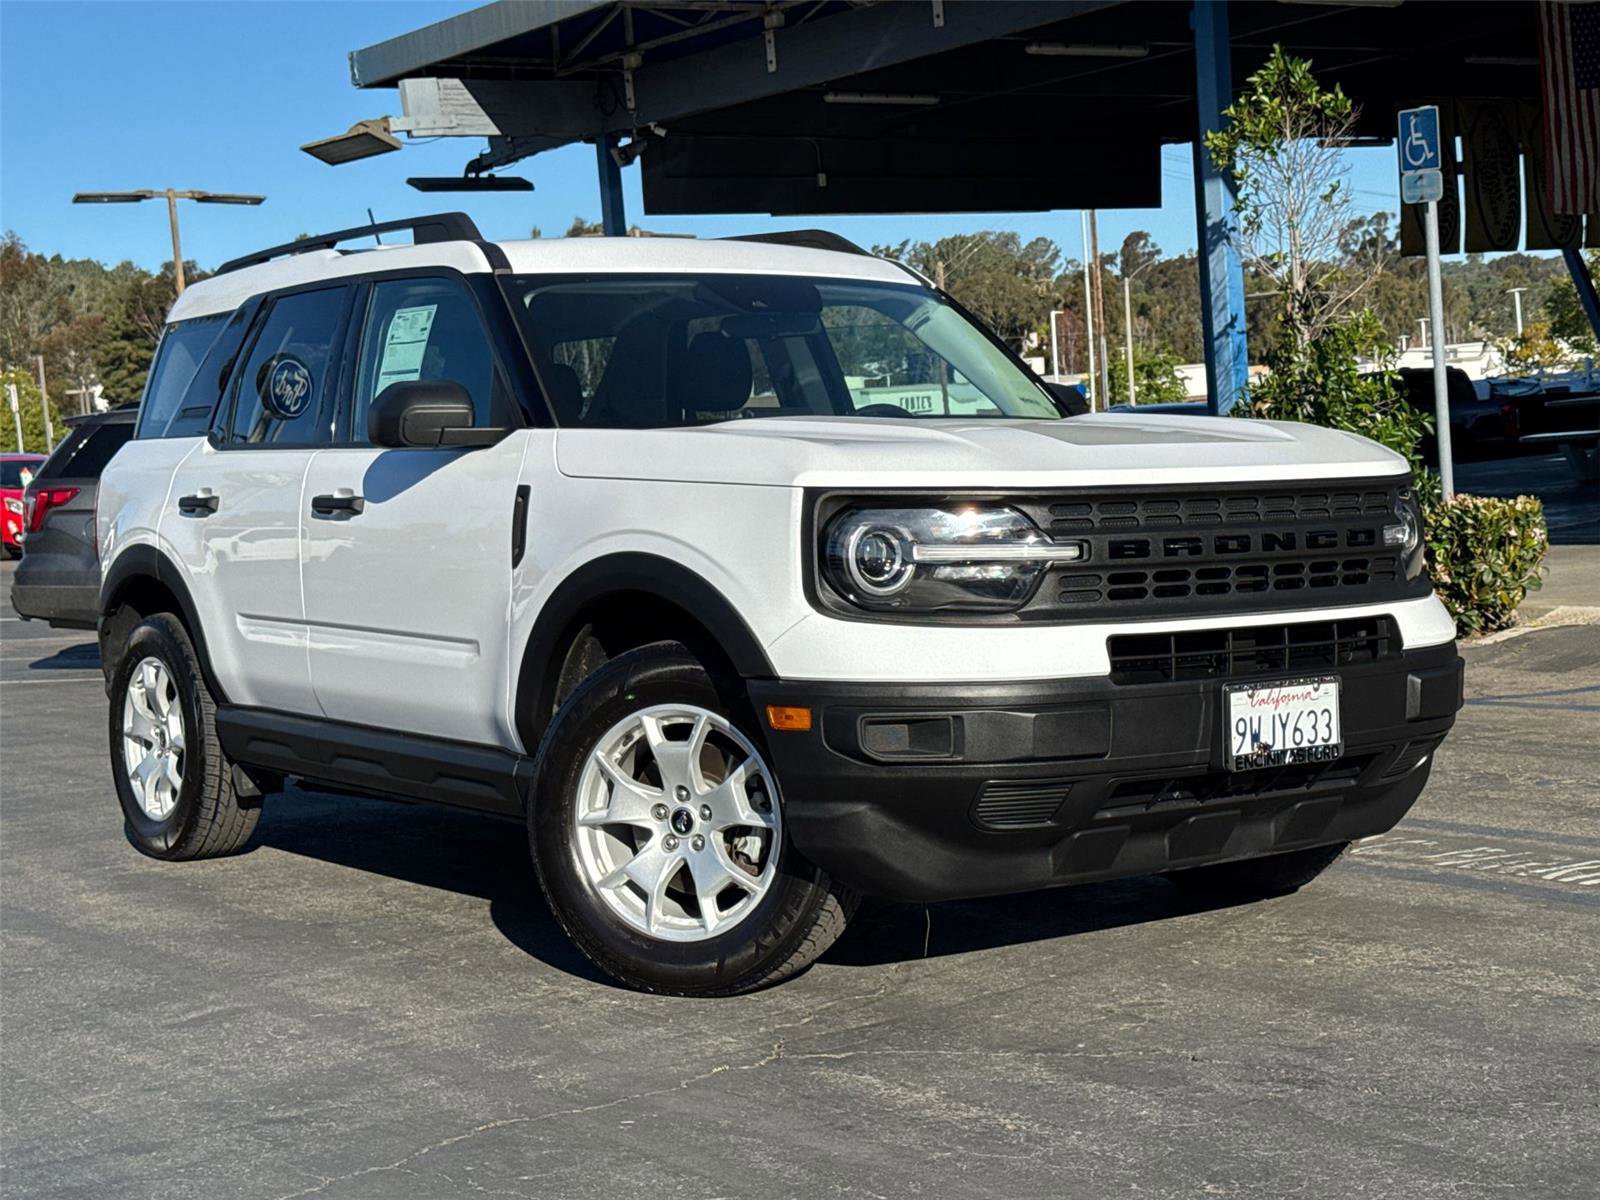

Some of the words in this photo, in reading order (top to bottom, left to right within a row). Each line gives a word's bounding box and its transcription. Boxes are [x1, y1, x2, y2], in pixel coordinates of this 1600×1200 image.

[1108, 529, 1375, 560] BRONCO
[1250, 689, 1319, 710] California
[1235, 708, 1332, 753] 9WJY633
[1307, 745, 1340, 761] FORD
